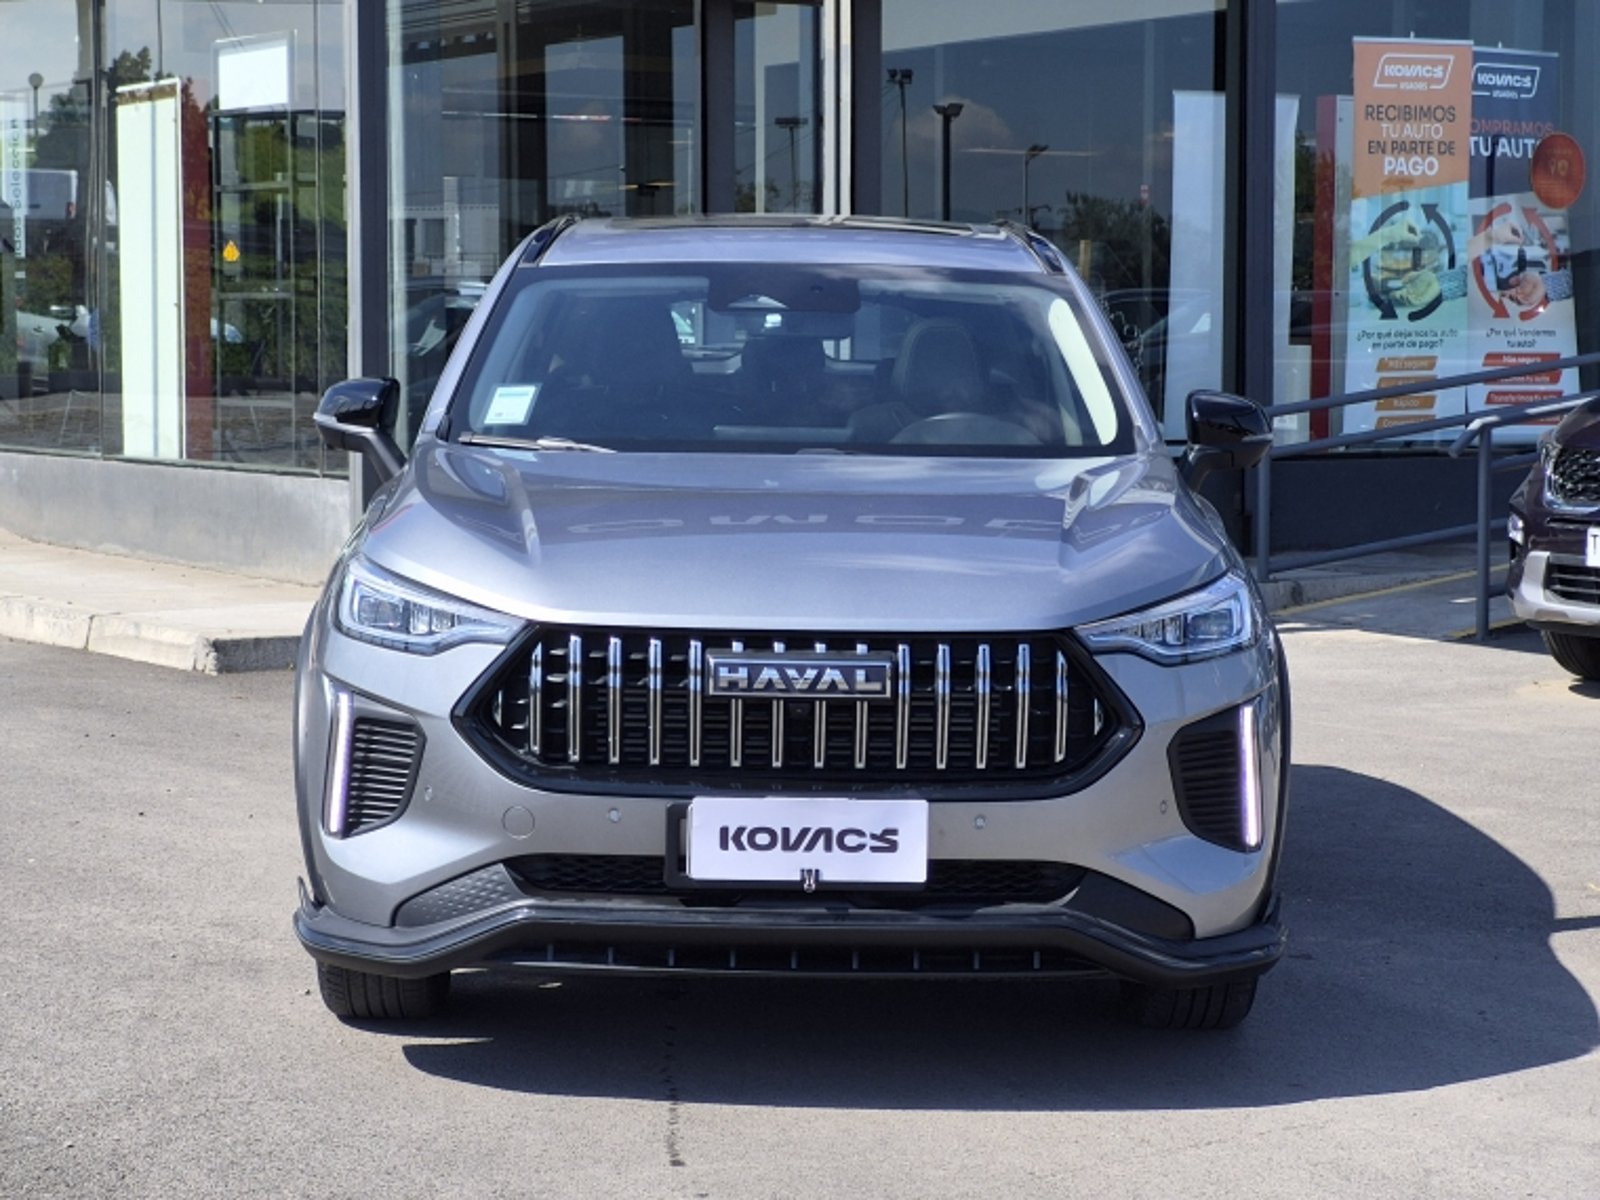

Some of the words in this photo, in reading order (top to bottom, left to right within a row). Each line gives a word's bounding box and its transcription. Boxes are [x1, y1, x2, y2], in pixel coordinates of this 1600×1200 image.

[1384, 65, 1444, 78] KOVACS
[1477, 72, 1532, 87] KOVACS
[1365, 104, 1456, 122] RECIBIMOS
[1381, 123, 1399, 138] TU
[1403, 123, 1443, 139] AUTO
[1470, 118, 1554, 137] OMPRAMOS
[1368, 140, 1386, 155] EN
[1391, 140, 1434, 155] PARTE
[1437, 140, 1455, 155] DE
[1469, 136, 1491, 156] TU
[1497, 138, 1542, 159] AUT
[1384, 155, 1439, 176] PAGO
[718, 666, 883, 691] HAVAL
[719, 825, 900, 853] KOVACS
